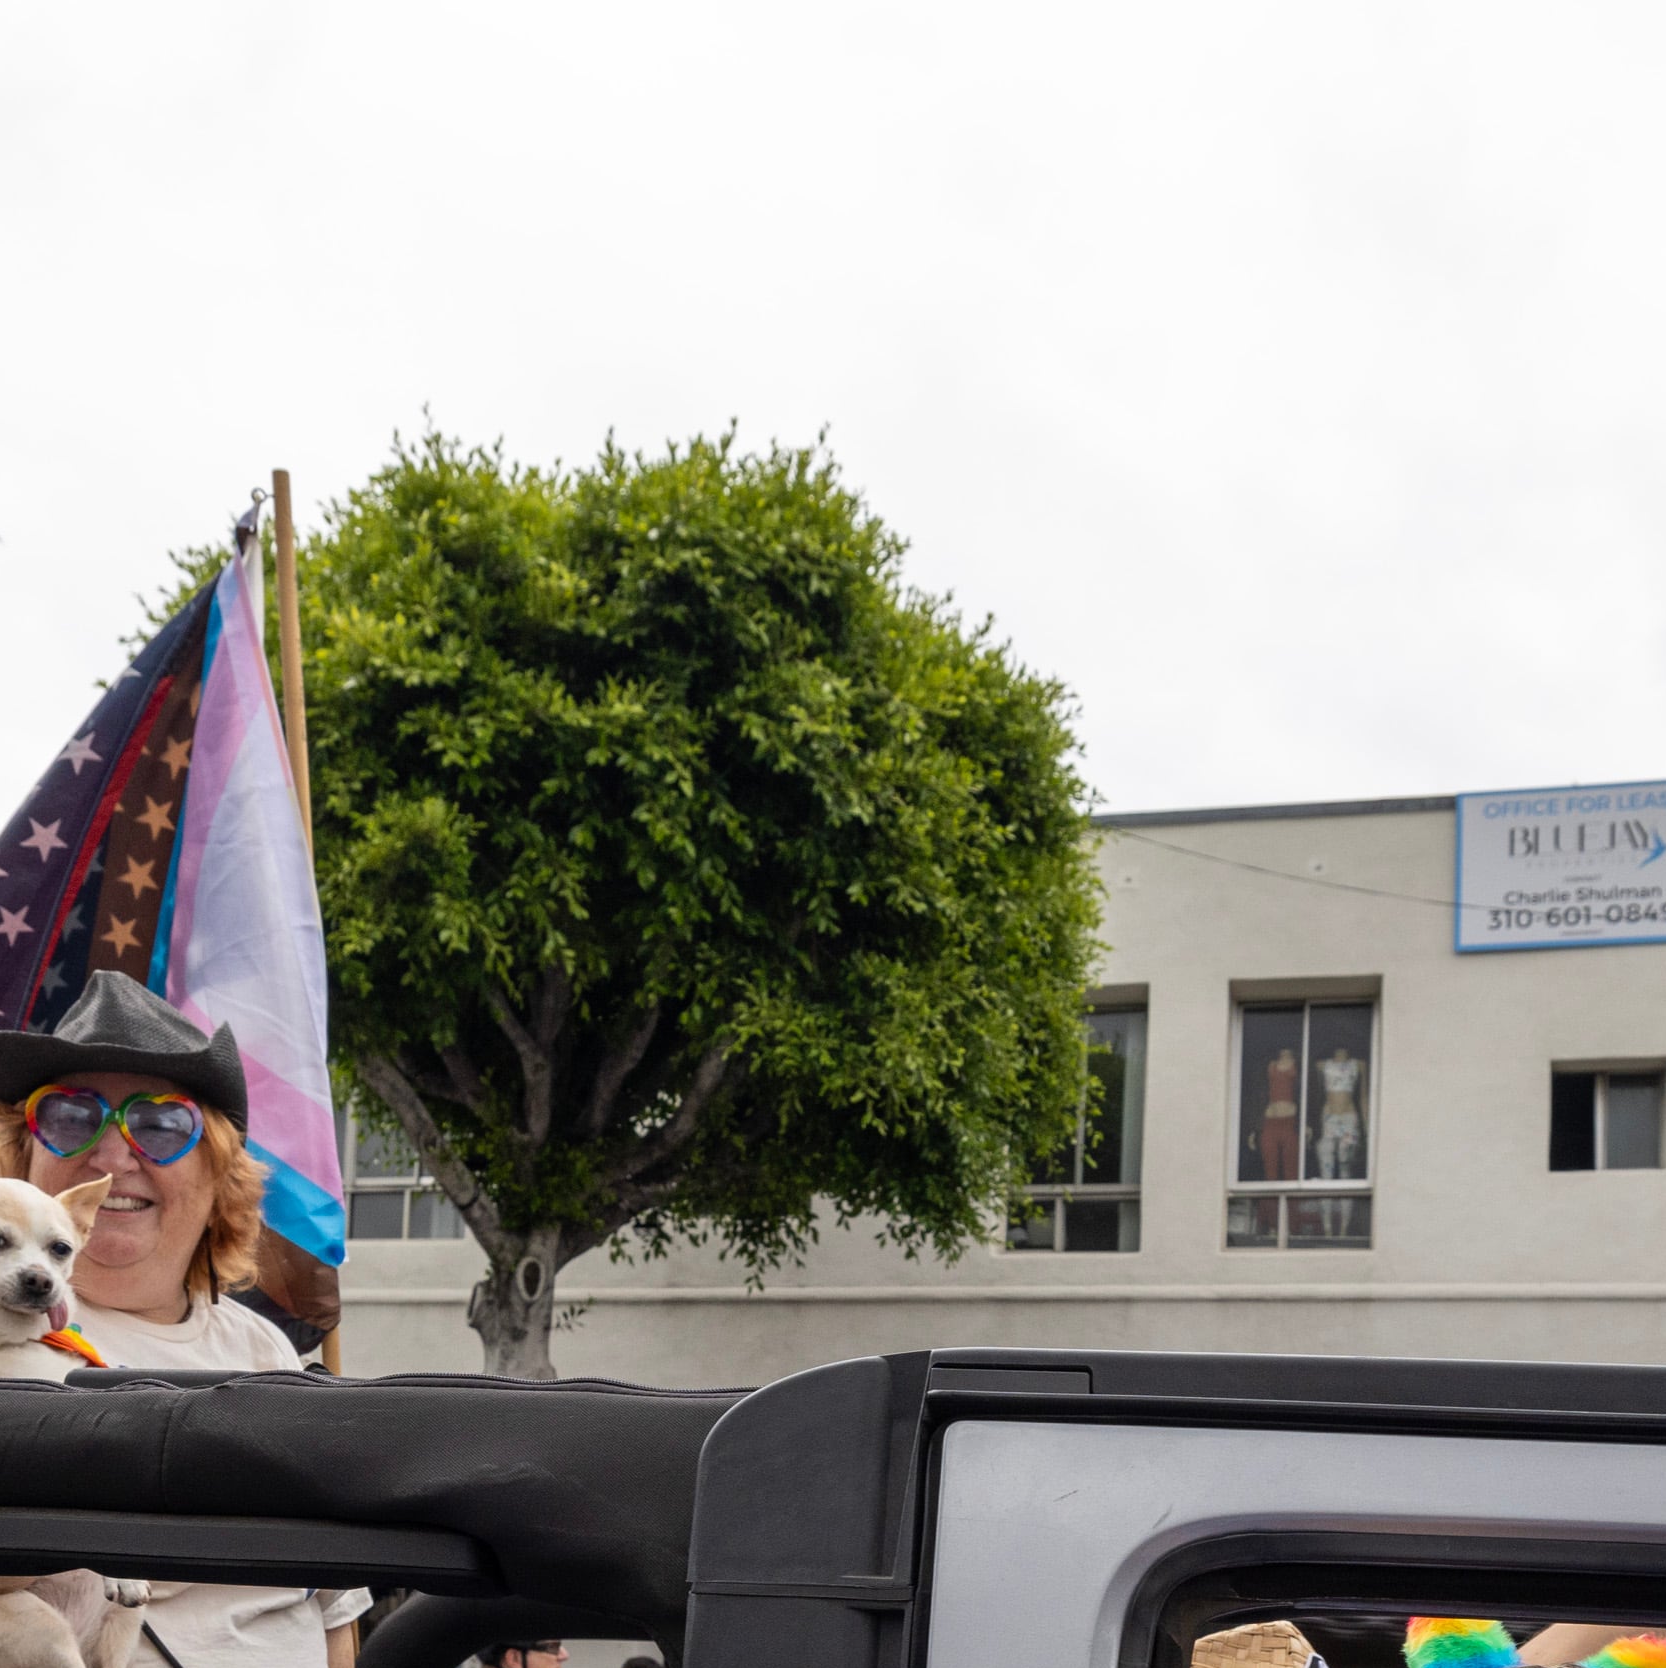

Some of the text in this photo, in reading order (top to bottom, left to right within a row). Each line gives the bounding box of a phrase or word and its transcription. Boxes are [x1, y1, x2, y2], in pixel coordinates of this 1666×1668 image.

[1483, 797, 1561, 819] OFFICE
[1566, 793, 1611, 813] FOR
[1503, 885, 1663, 906] Charlie Shulman
